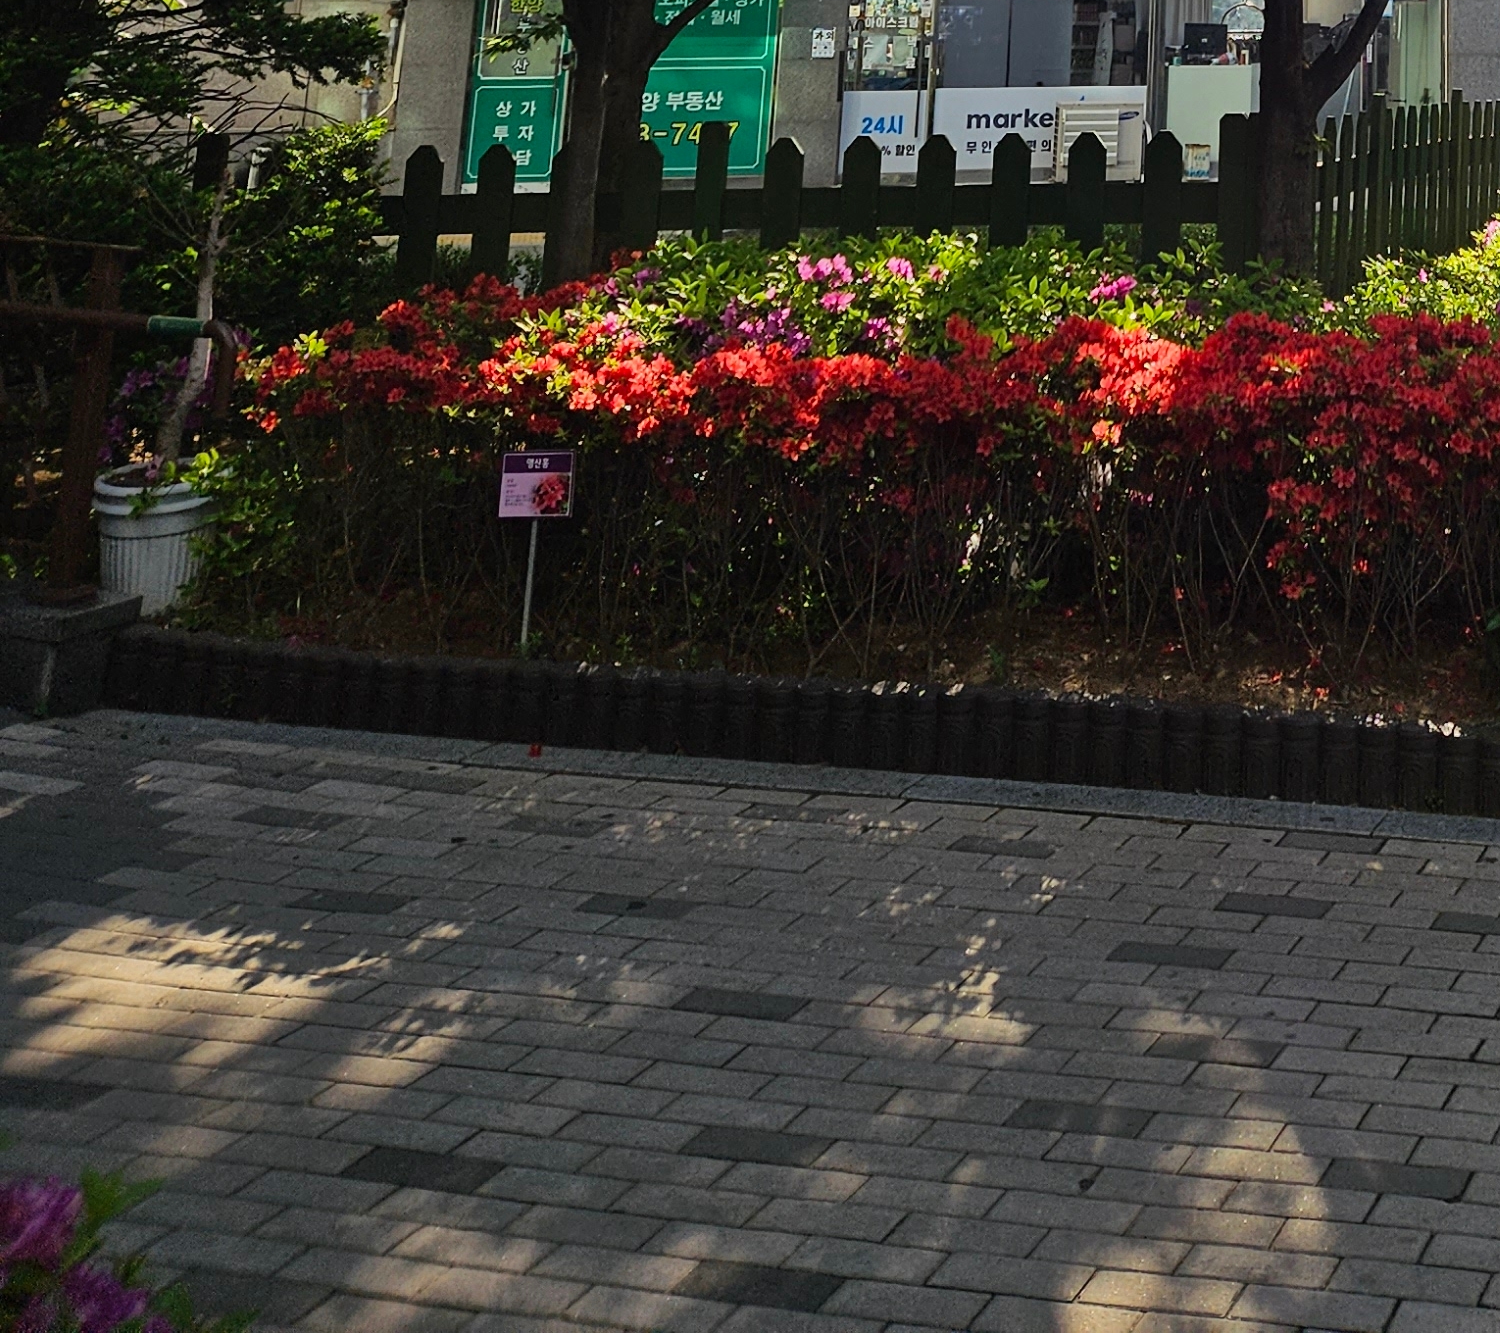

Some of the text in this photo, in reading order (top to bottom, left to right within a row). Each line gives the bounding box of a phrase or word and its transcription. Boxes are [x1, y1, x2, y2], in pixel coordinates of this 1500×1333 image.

[710, 9, 741, 25] 월세
[495, 100, 537, 118] 상가
[641, 90, 724, 113] 양 부동산
[861, 114, 904, 135] 24시
[966, 108, 1054, 129] marke
[491, 124, 535, 142] 투자
[895, 144, 916, 157] 할인
